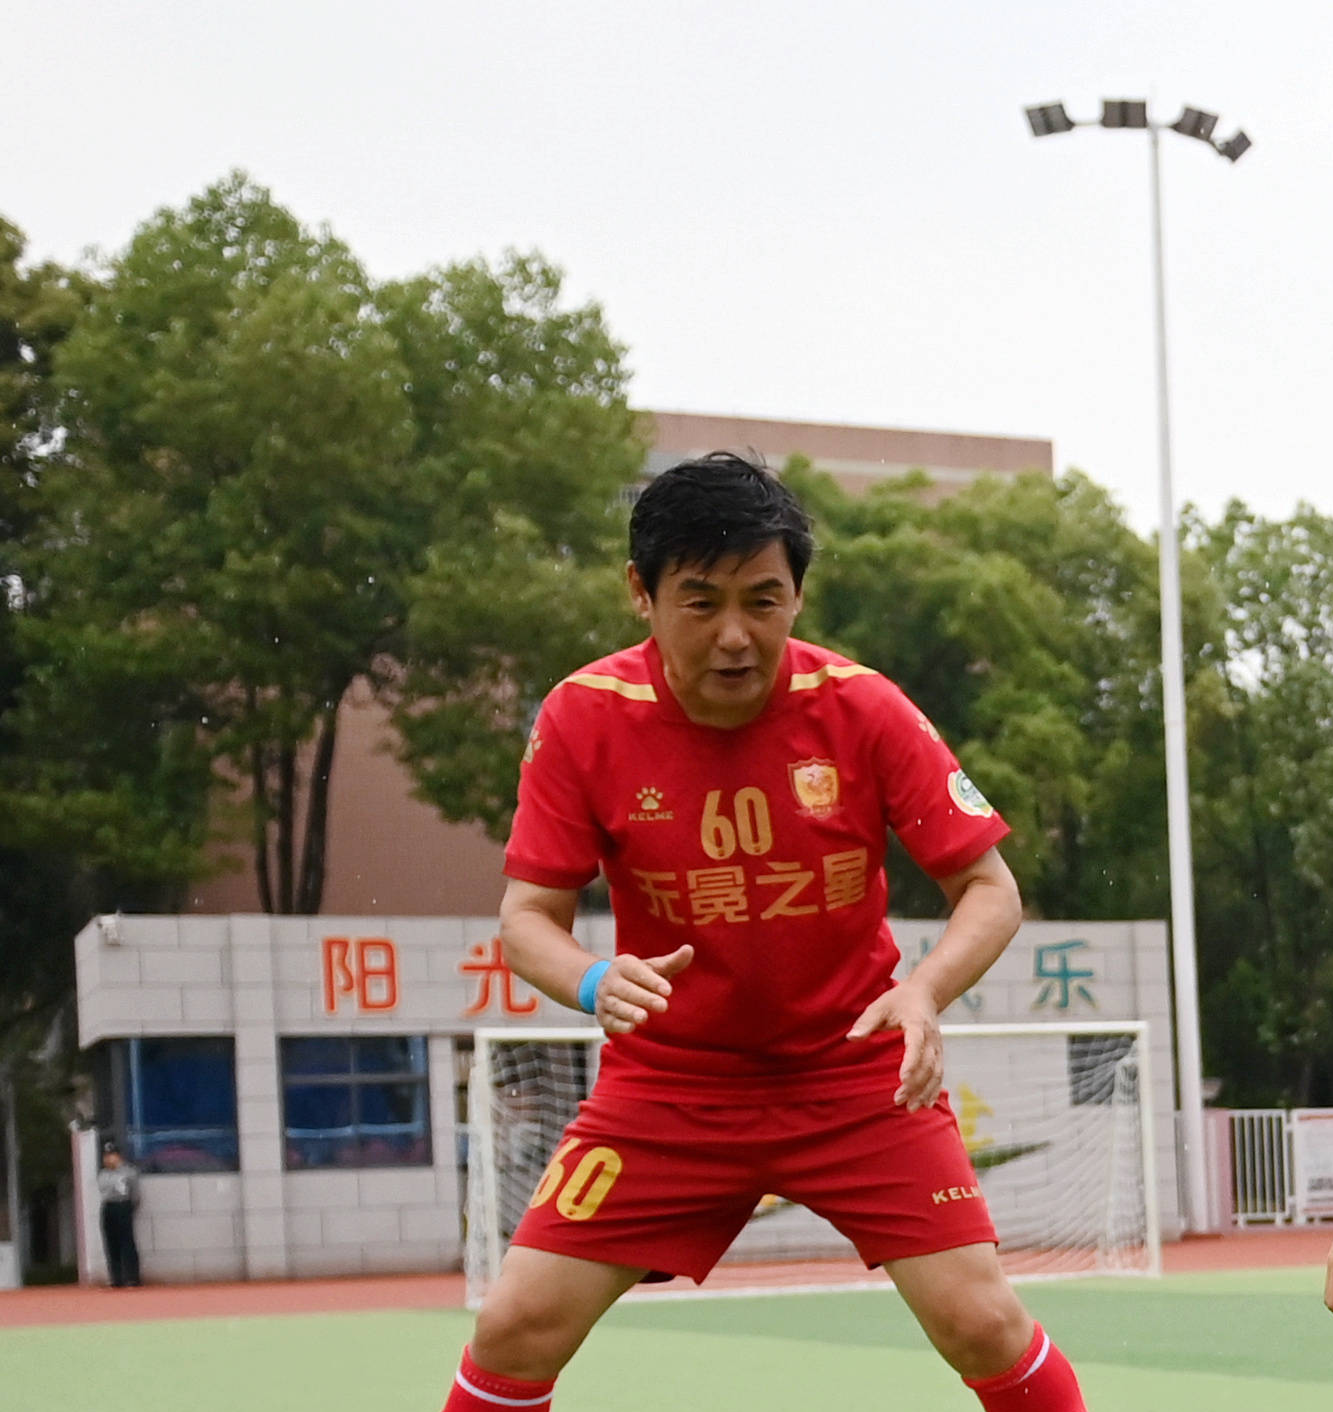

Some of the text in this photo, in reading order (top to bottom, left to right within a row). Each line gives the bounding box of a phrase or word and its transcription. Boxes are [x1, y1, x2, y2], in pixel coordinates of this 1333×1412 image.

[629, 810, 674, 822] KELME
[701, 787, 772, 860] 60
[631, 847, 868, 925] 无冕之星
[529, 1138, 622, 1221] 60
